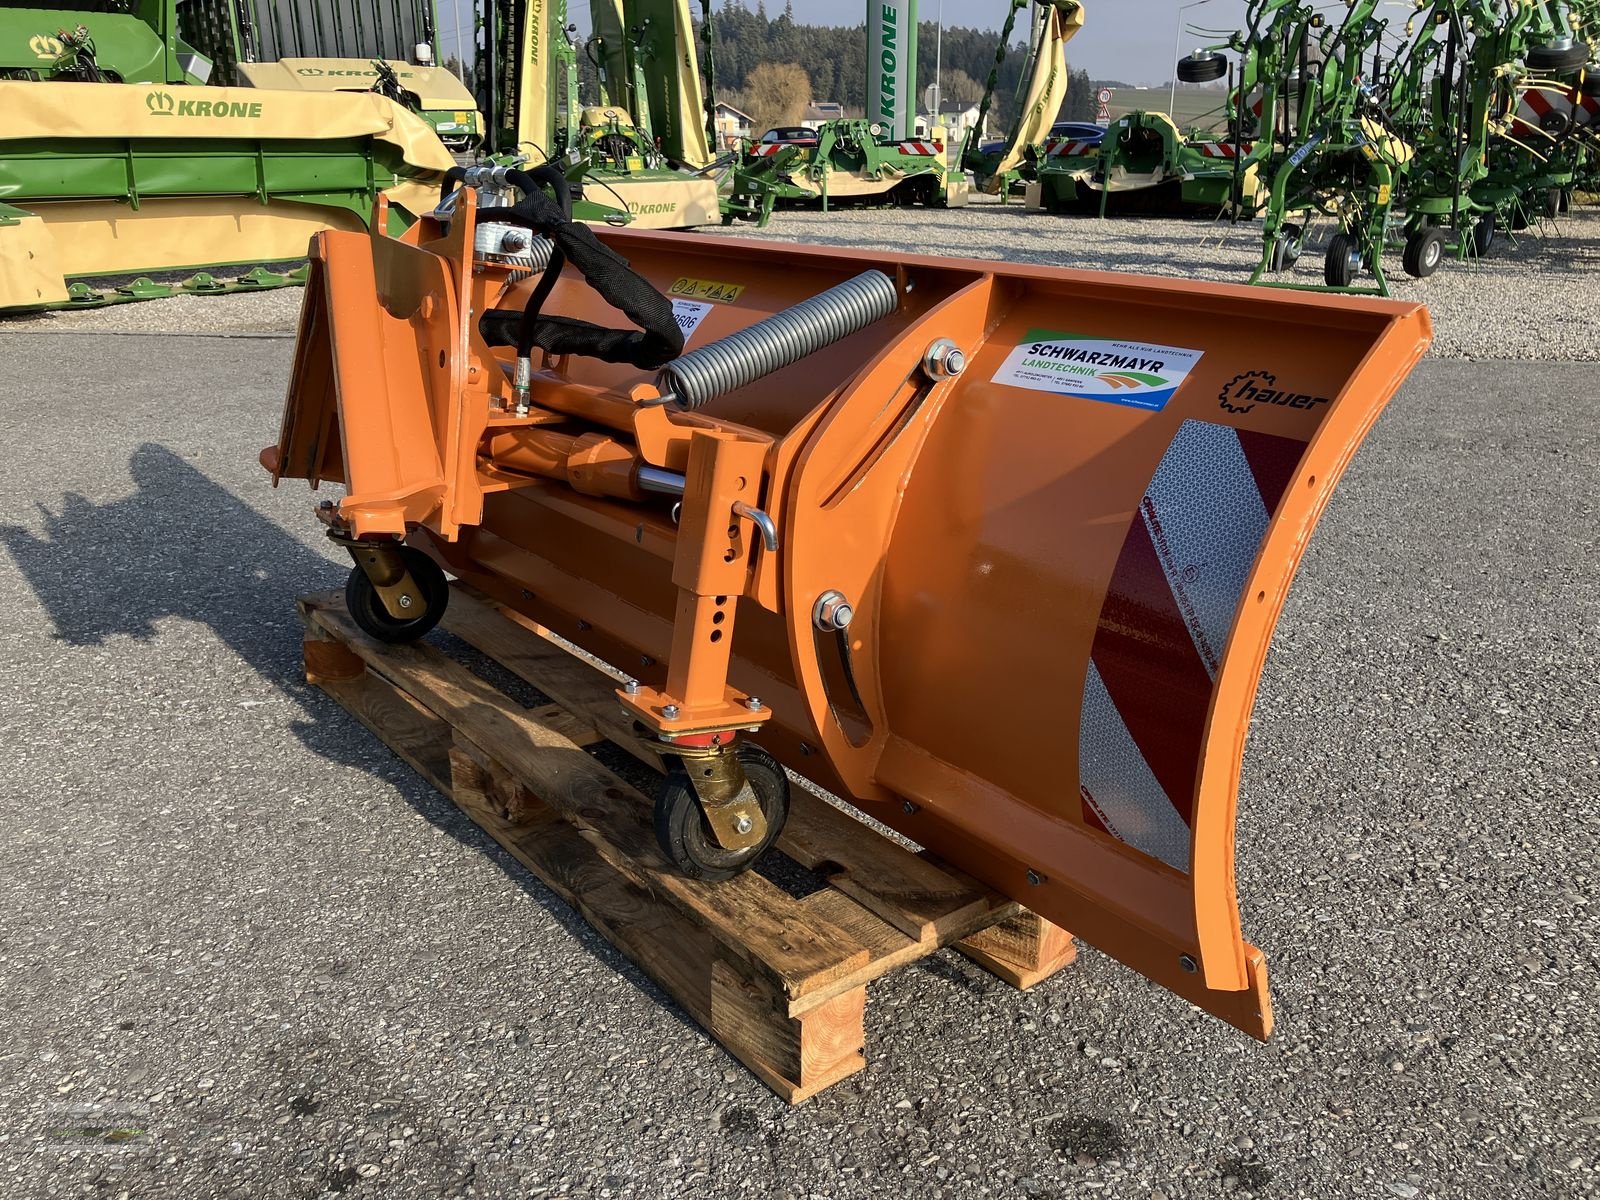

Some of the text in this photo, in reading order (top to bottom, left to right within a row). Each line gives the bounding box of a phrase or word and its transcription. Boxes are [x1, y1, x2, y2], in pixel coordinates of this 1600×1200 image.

[531, 15, 539, 66] KRONE
[881, 4, 897, 119] KRONE
[328, 70, 414, 78] KROE
[178, 101, 262, 118] KRONE
[639, 202, 676, 215] KRONE
[1028, 343, 1164, 373] SCHWARZMAYR
[1153, 348, 1193, 358] LANDTECHNIK
[1021, 358, 1098, 377] LANDTECHNIK
[1234, 380, 1329, 410] hauer
